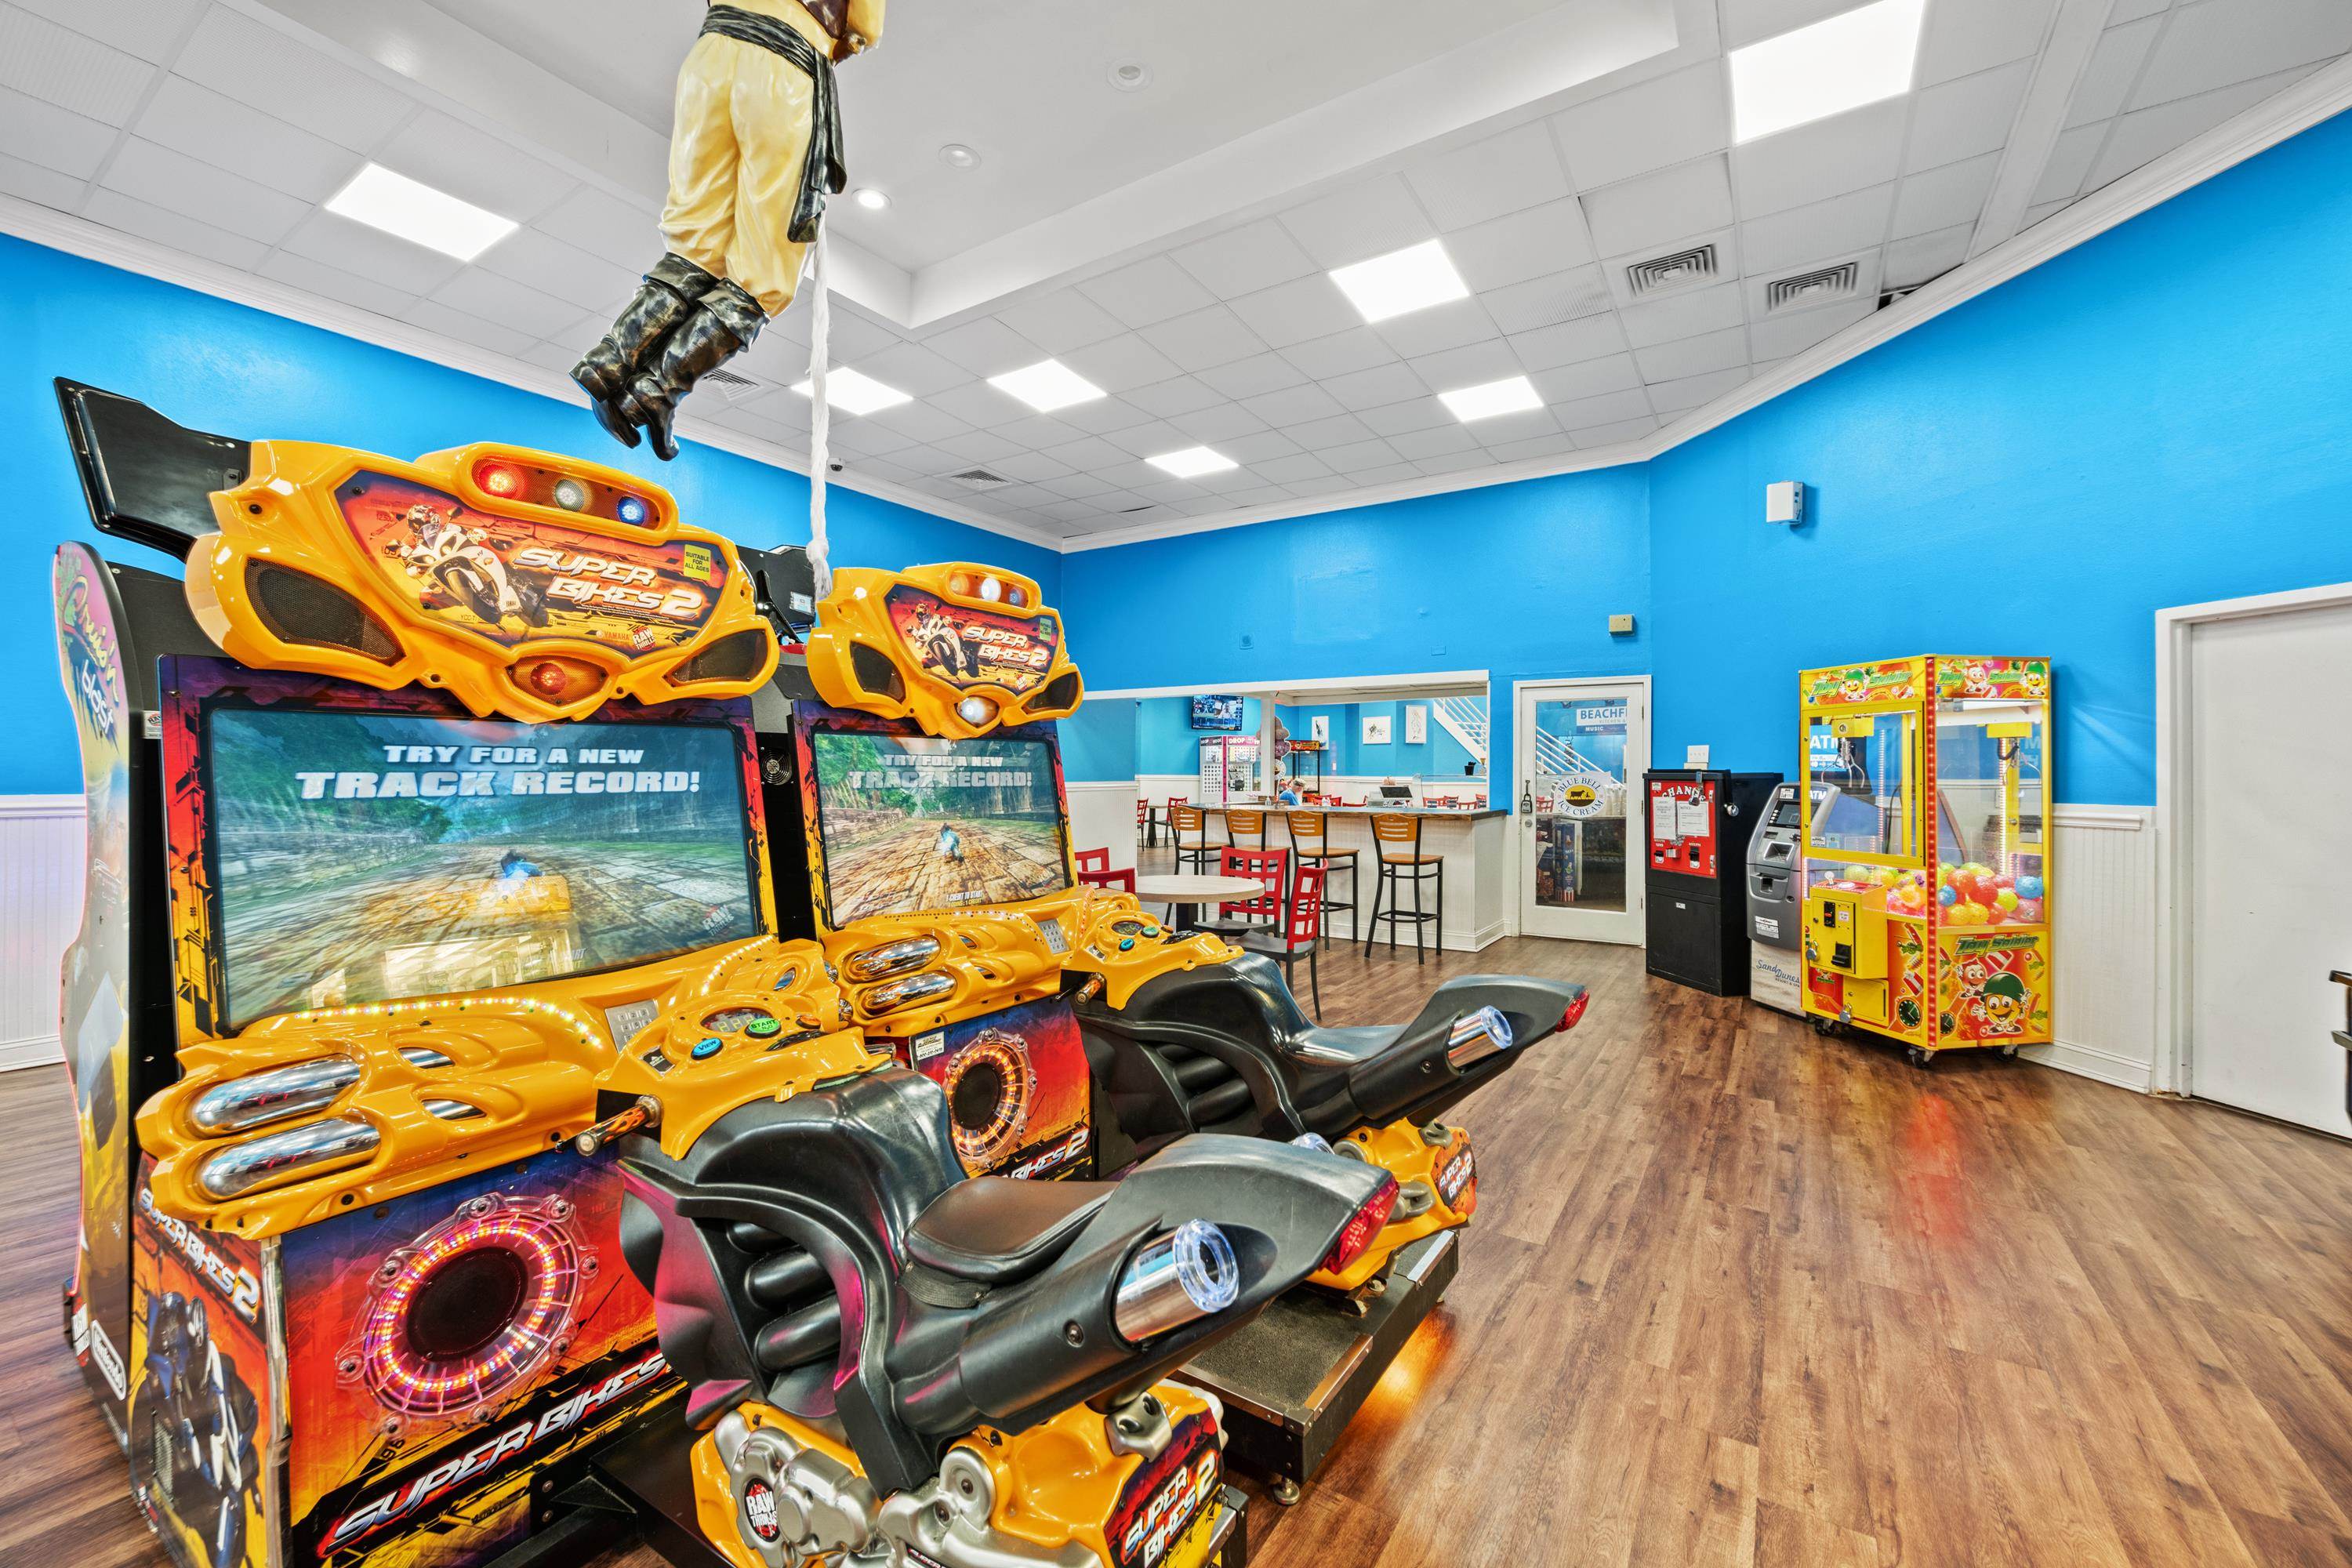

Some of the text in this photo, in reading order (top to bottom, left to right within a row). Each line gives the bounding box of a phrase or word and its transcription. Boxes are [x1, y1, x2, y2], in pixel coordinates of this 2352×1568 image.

[685, 551, 710, 561] SUITABLE
[514, 548, 658, 586] SUPER
[546, 578, 665, 610] BIKES
[659, 588, 703, 619] 2
[604, 631, 629, 641] YAMAHA
[632, 627, 653, 643] RAW
[635, 637, 655, 650] THRILLS
[964, 626, 1028, 648] SUPER
[978, 644, 1031, 662] BIKES
[1029, 648, 1049, 668] 2
[1987, 669, 2023, 684] Soldi
[383, 745, 645, 764] TRY FOR A NEW
[884, 754, 1004, 767] TRY FOR A NEW
[296, 771, 700, 799] TRACK RECORD!
[848, 771, 1033, 789] TRACK RECORD!
[1558, 777, 1600, 793] BLUE BELL
[1809, 789, 1826, 800] ATM
[1558, 800, 1603, 815] ICE CREAM
[1954, 935, 1989, 956] Toy
[1756, 959, 1777, 973] Sand
[1775, 968, 1800, 984] Dunes
[750, 1019, 777, 1029] START
[698, 1039, 717, 1051] VIEW
[1064, 1128, 1089, 1161] 2
[1465, 1152, 1472, 1174] 2
[1439, 1156, 1461, 1189] SUPER
[186, 1231, 236, 1296] BIKES
[234, 1266, 260, 1325] 2
[325, 1352, 667, 1555] SUPER BIKES
[746, 1491, 776, 1515] RAW
[1144, 1452, 1216, 1568] BIKES 2
[750, 1510, 779, 1528] THRILLS
[1124, 1466, 1189, 1562] SUPER
